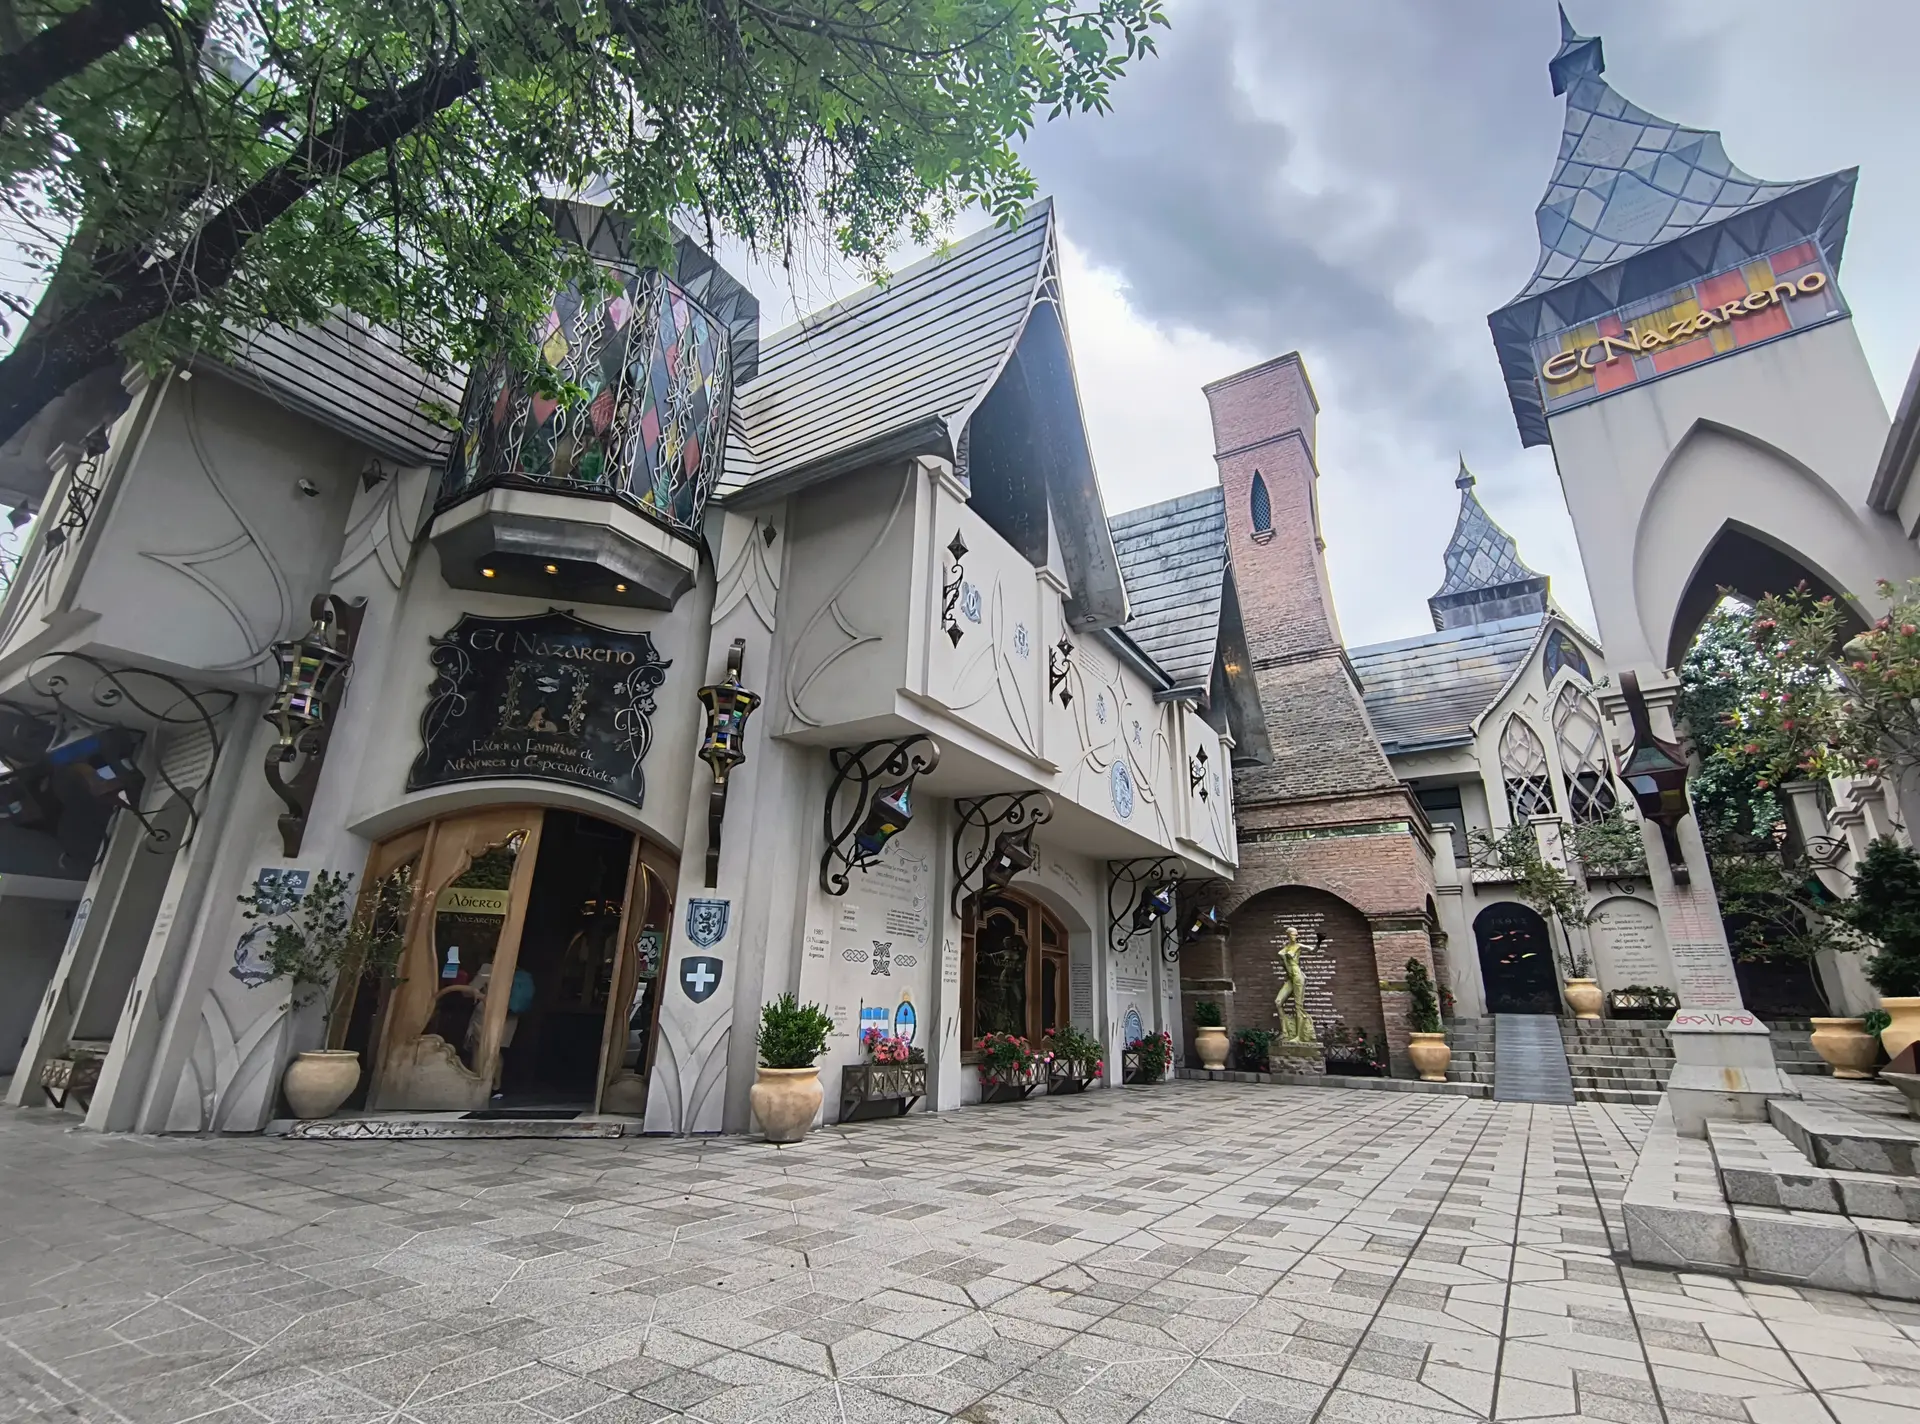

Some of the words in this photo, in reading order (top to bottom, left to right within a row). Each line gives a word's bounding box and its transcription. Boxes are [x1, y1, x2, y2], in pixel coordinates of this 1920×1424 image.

[1542, 346, 1597, 380] El
[1599, 271, 1827, 361] Nazareno
[470, 628, 504, 652] El
[512, 630, 636, 665] Nazareno
[525, 738, 577, 757] Familiar
[580, 749, 594, 761] de
[510, 758, 520, 768] y
[523, 754, 618, 784] Especialidades
[448, 893, 502, 909] Abierto
[1704, 1013, 1721, 1026] VI
[302, 1123, 341, 1136] El
